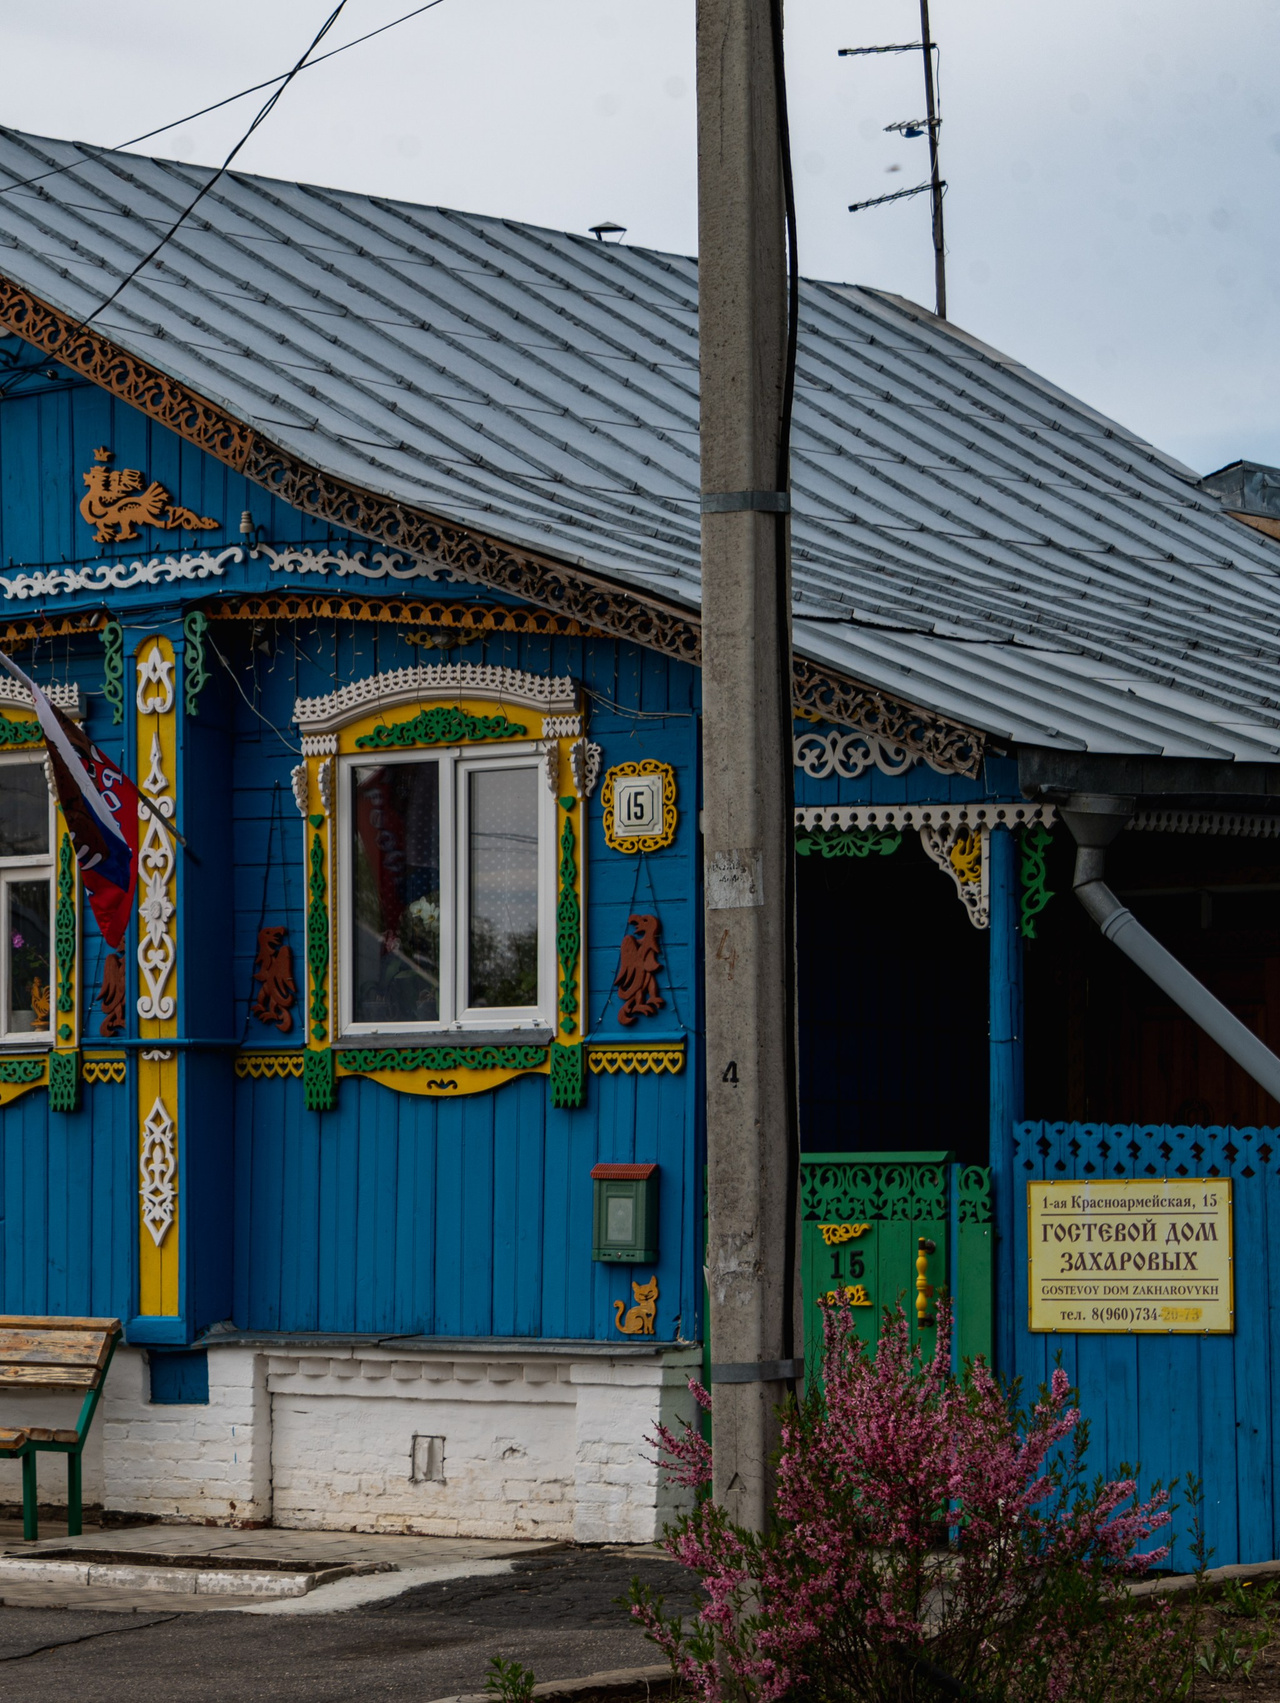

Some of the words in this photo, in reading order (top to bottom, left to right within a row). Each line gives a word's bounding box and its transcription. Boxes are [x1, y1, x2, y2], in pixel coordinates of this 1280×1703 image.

[627, 791, 645, 821] 15
[722, 1060, 740, 1088] 4
[1042, 1195, 1067, 1209] 1-ая
[1071, 1194, 1196, 1212] Красноармейская,
[1203, 1193, 1218, 1208] 15
[1041, 1218, 1157, 1243] ГОСТЕВОЙ
[1165, 1221, 1219, 1246] ДОМ
[830, 1250, 865, 1280] 15
[1060, 1251, 1199, 1273] ЗАХАРОВЫХ
[1041, 1285, 1099, 1295] GOSTEVOY
[1103, 1285, 1129, 1295] DOM
[1132, 1285, 1218, 1295] ZAKHAROVYKH
[1060, 1311, 1086, 1320] тел.
